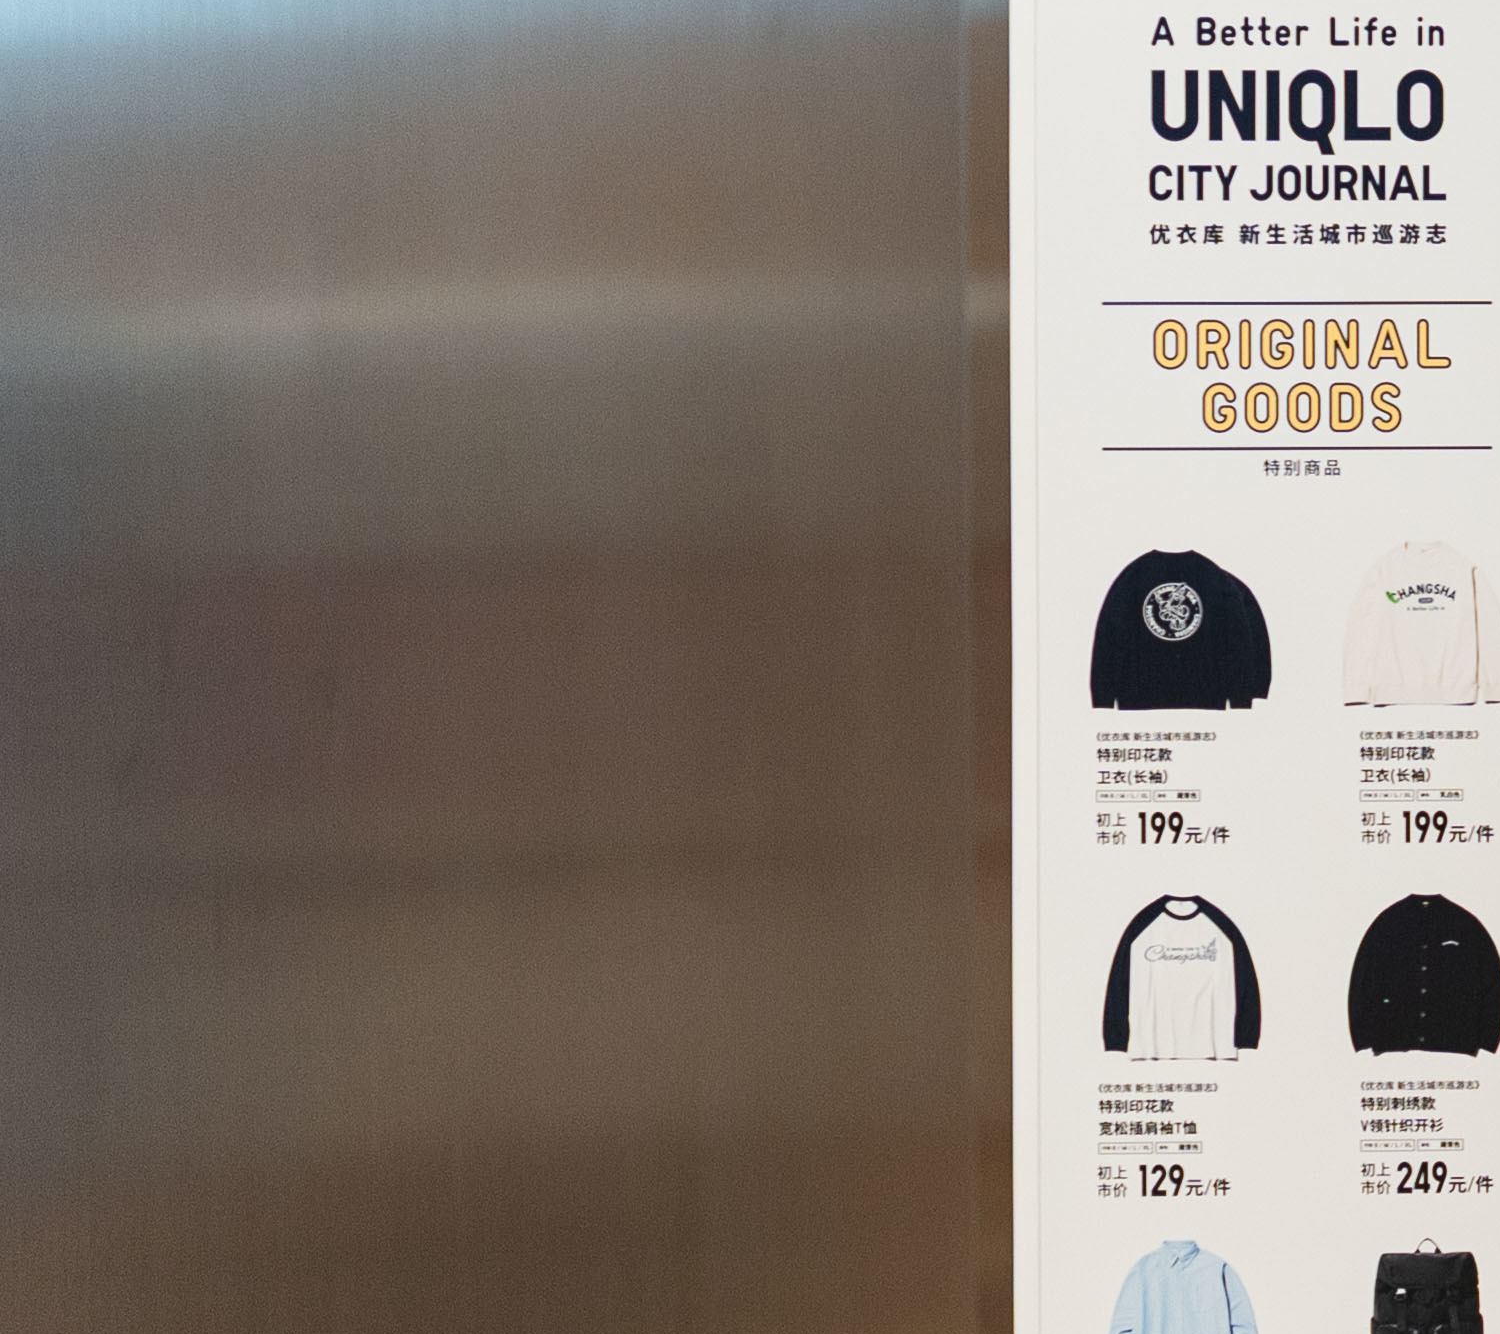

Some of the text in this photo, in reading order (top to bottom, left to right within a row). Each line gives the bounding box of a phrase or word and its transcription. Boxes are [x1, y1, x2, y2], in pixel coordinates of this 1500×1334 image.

[1151, 16, 1444, 46] A Better Life in
[1151, 69, 1444, 155] UNIQLO
[1149, 165, 1446, 201] CITY JOURNAL
[1150, 223, 1446, 244] 优衣库 新生活城市巡游志
[1153, 319, 1452, 370] ORIGINAL
[1202, 382, 1402, 433] GOODS
[1264, 460, 1340, 476] 特别商品
[1097, 748, 1172, 762] 特别印花款
[1360, 746, 1435, 761] 特别印花款
[1099, 1099, 1174, 1114] 特别印花款
[1361, 1096, 1436, 1111] 特别刺绣款
